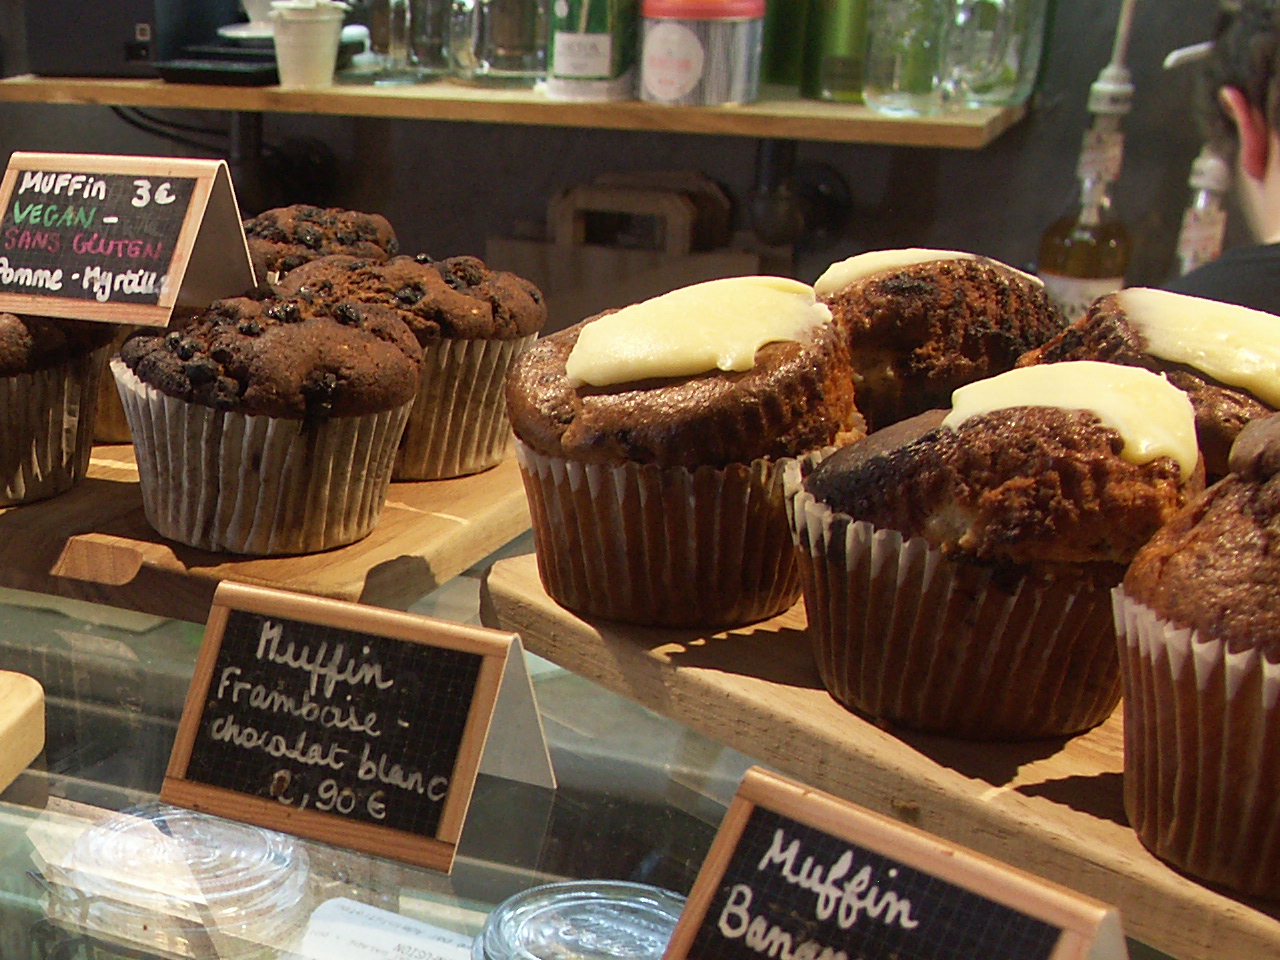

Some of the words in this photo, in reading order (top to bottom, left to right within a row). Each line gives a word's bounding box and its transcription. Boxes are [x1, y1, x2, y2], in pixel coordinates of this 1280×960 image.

[3, 228, 61, 253] SANS
[72, 232, 163, 260] GLUTEN
[13, 201, 96, 229] VEGAN
[255, 621, 394, 698] Muffin
[210, 714, 349, 770] chocolat
[358, 744, 449, 801] blanc
[758, 828, 920, 930] Muffin
